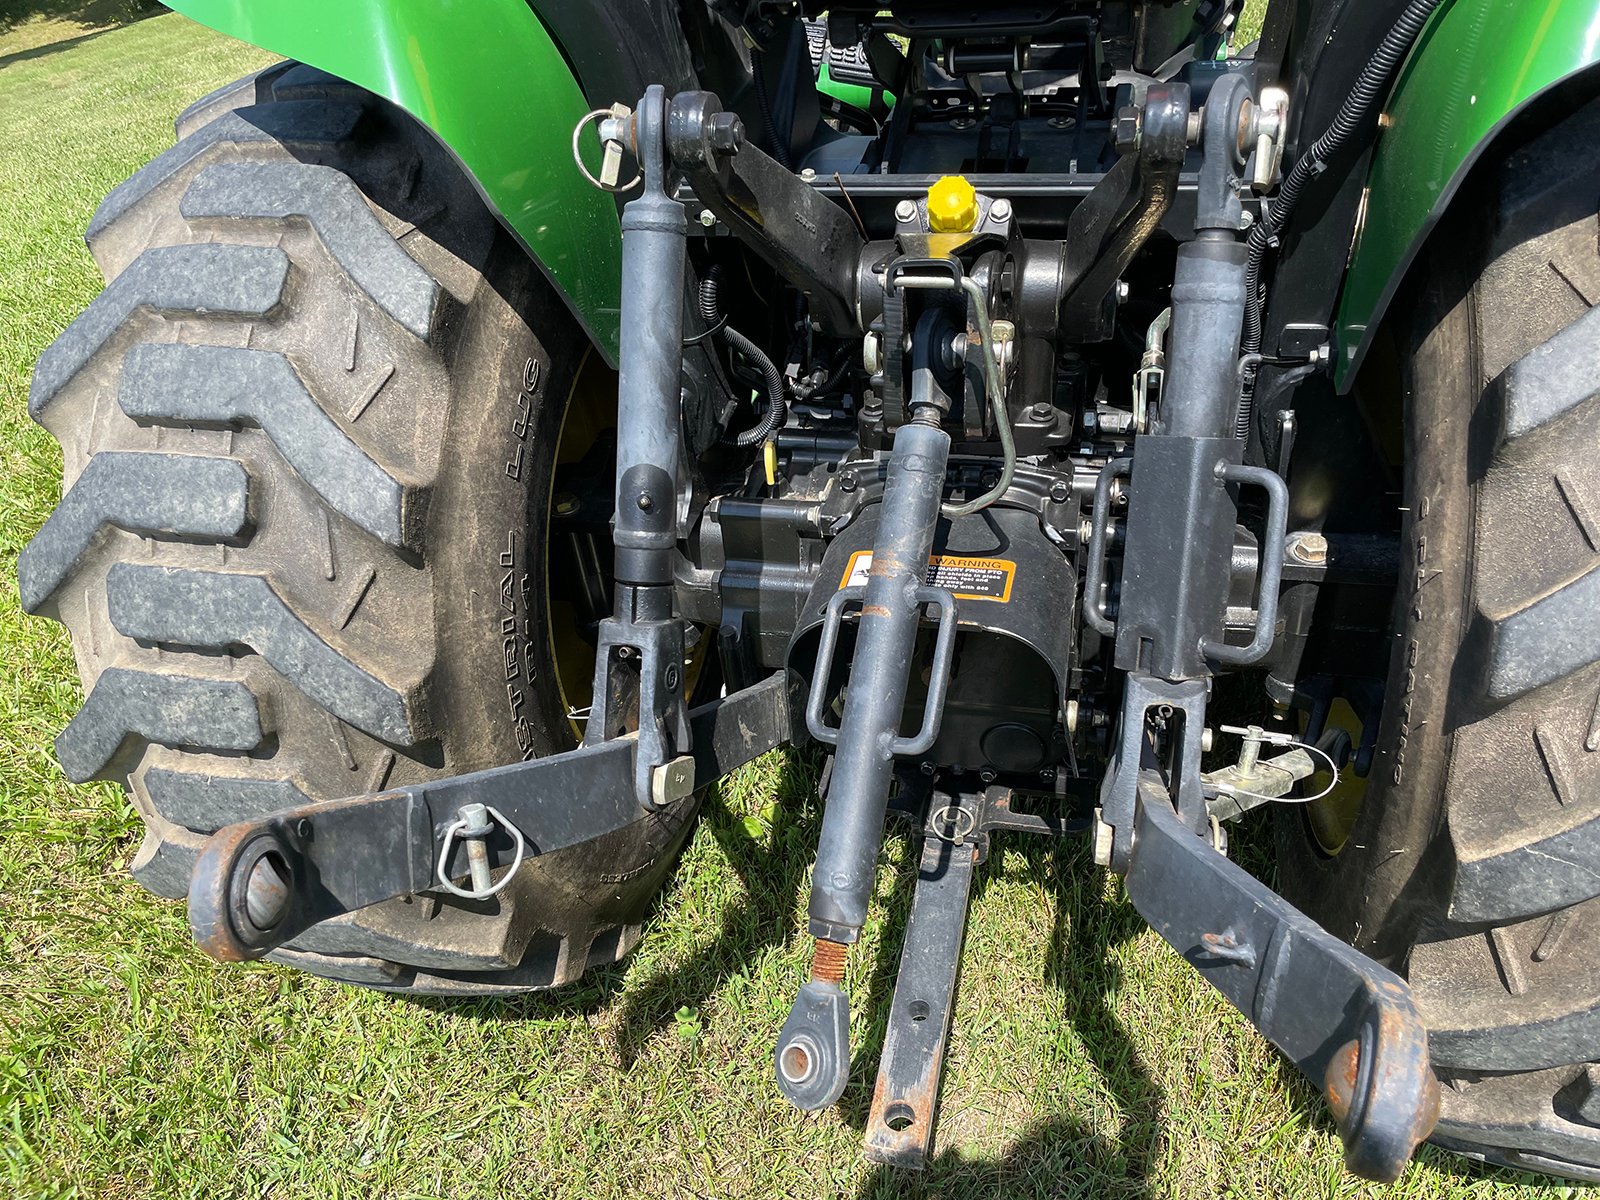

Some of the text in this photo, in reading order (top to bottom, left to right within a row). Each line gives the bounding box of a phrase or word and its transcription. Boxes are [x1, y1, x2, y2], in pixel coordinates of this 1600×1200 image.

[504, 356, 540, 482] LUG
[935, 557, 1001, 569] WARNING
[520, 573, 538, 686] R-4
[1393, 638, 1420, 787] RATING
